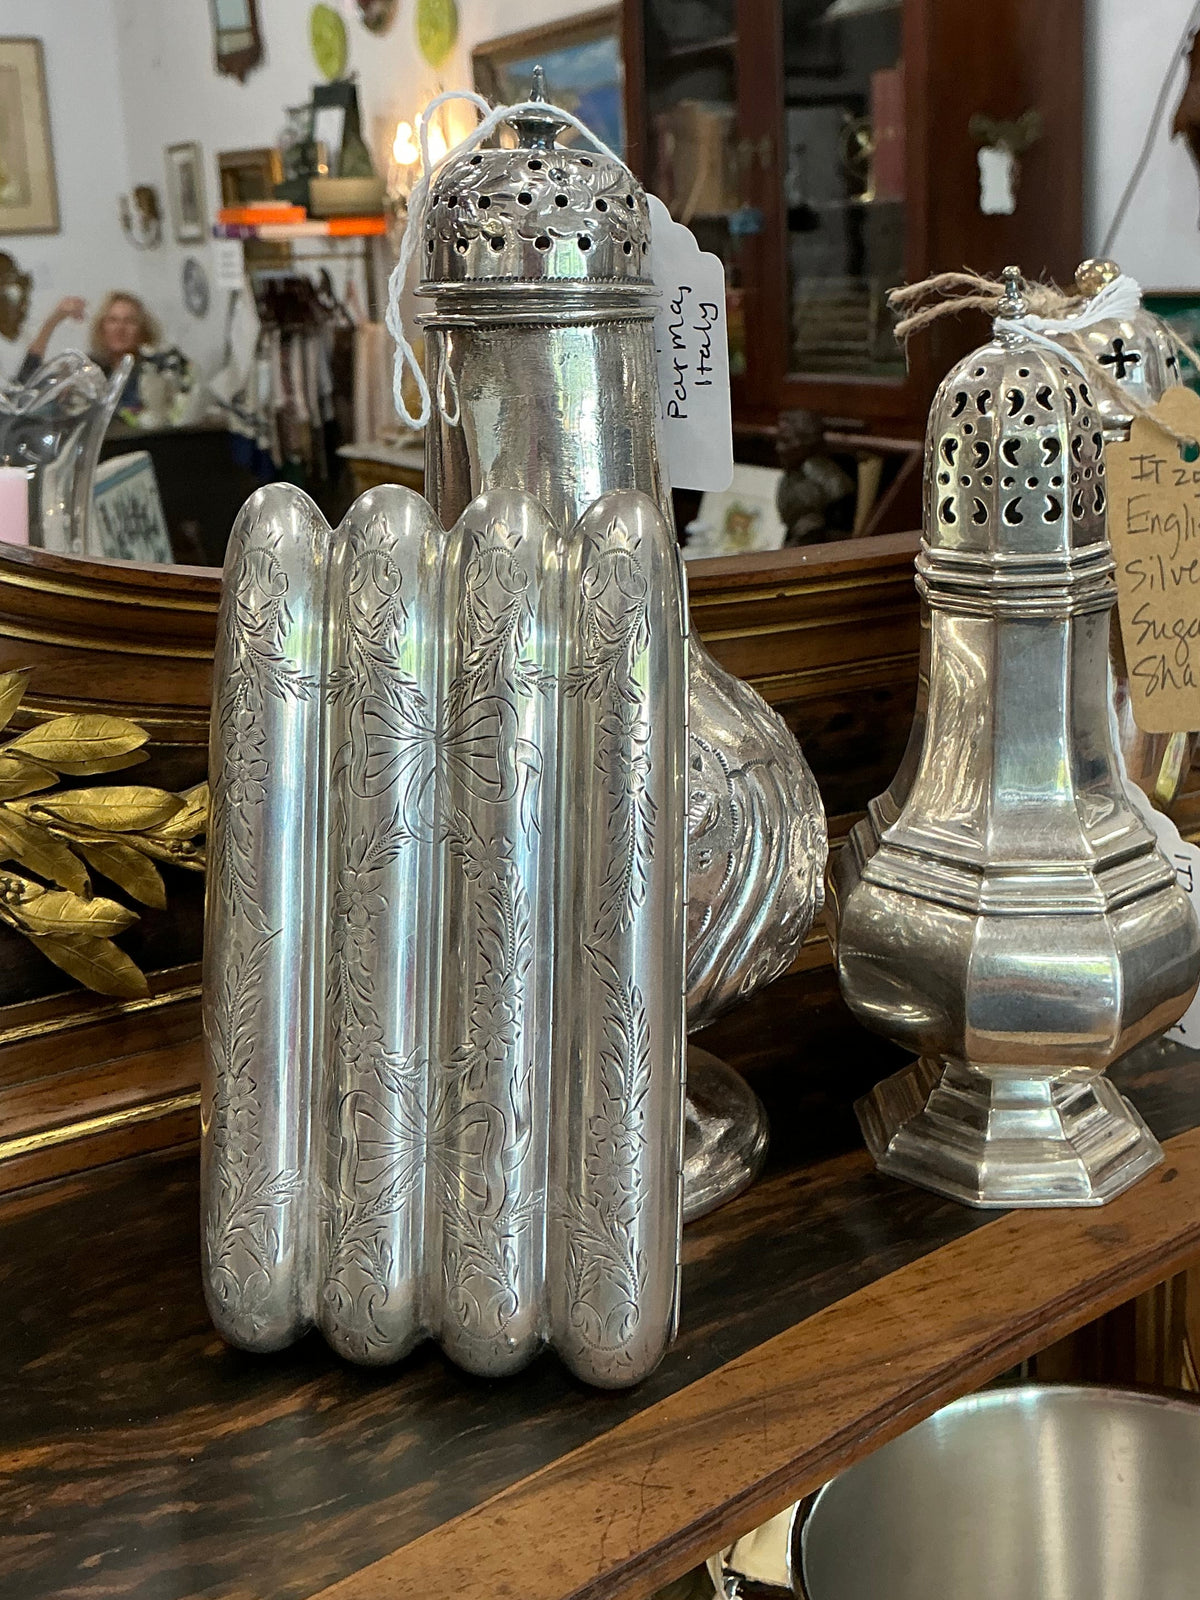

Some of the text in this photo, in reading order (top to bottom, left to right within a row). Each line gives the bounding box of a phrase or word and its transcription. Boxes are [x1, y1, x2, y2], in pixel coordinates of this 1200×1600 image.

[695, 302, 719, 386] Italy
[1129, 454, 1167, 484] IT
[1127, 493, 1200, 560] Engli
